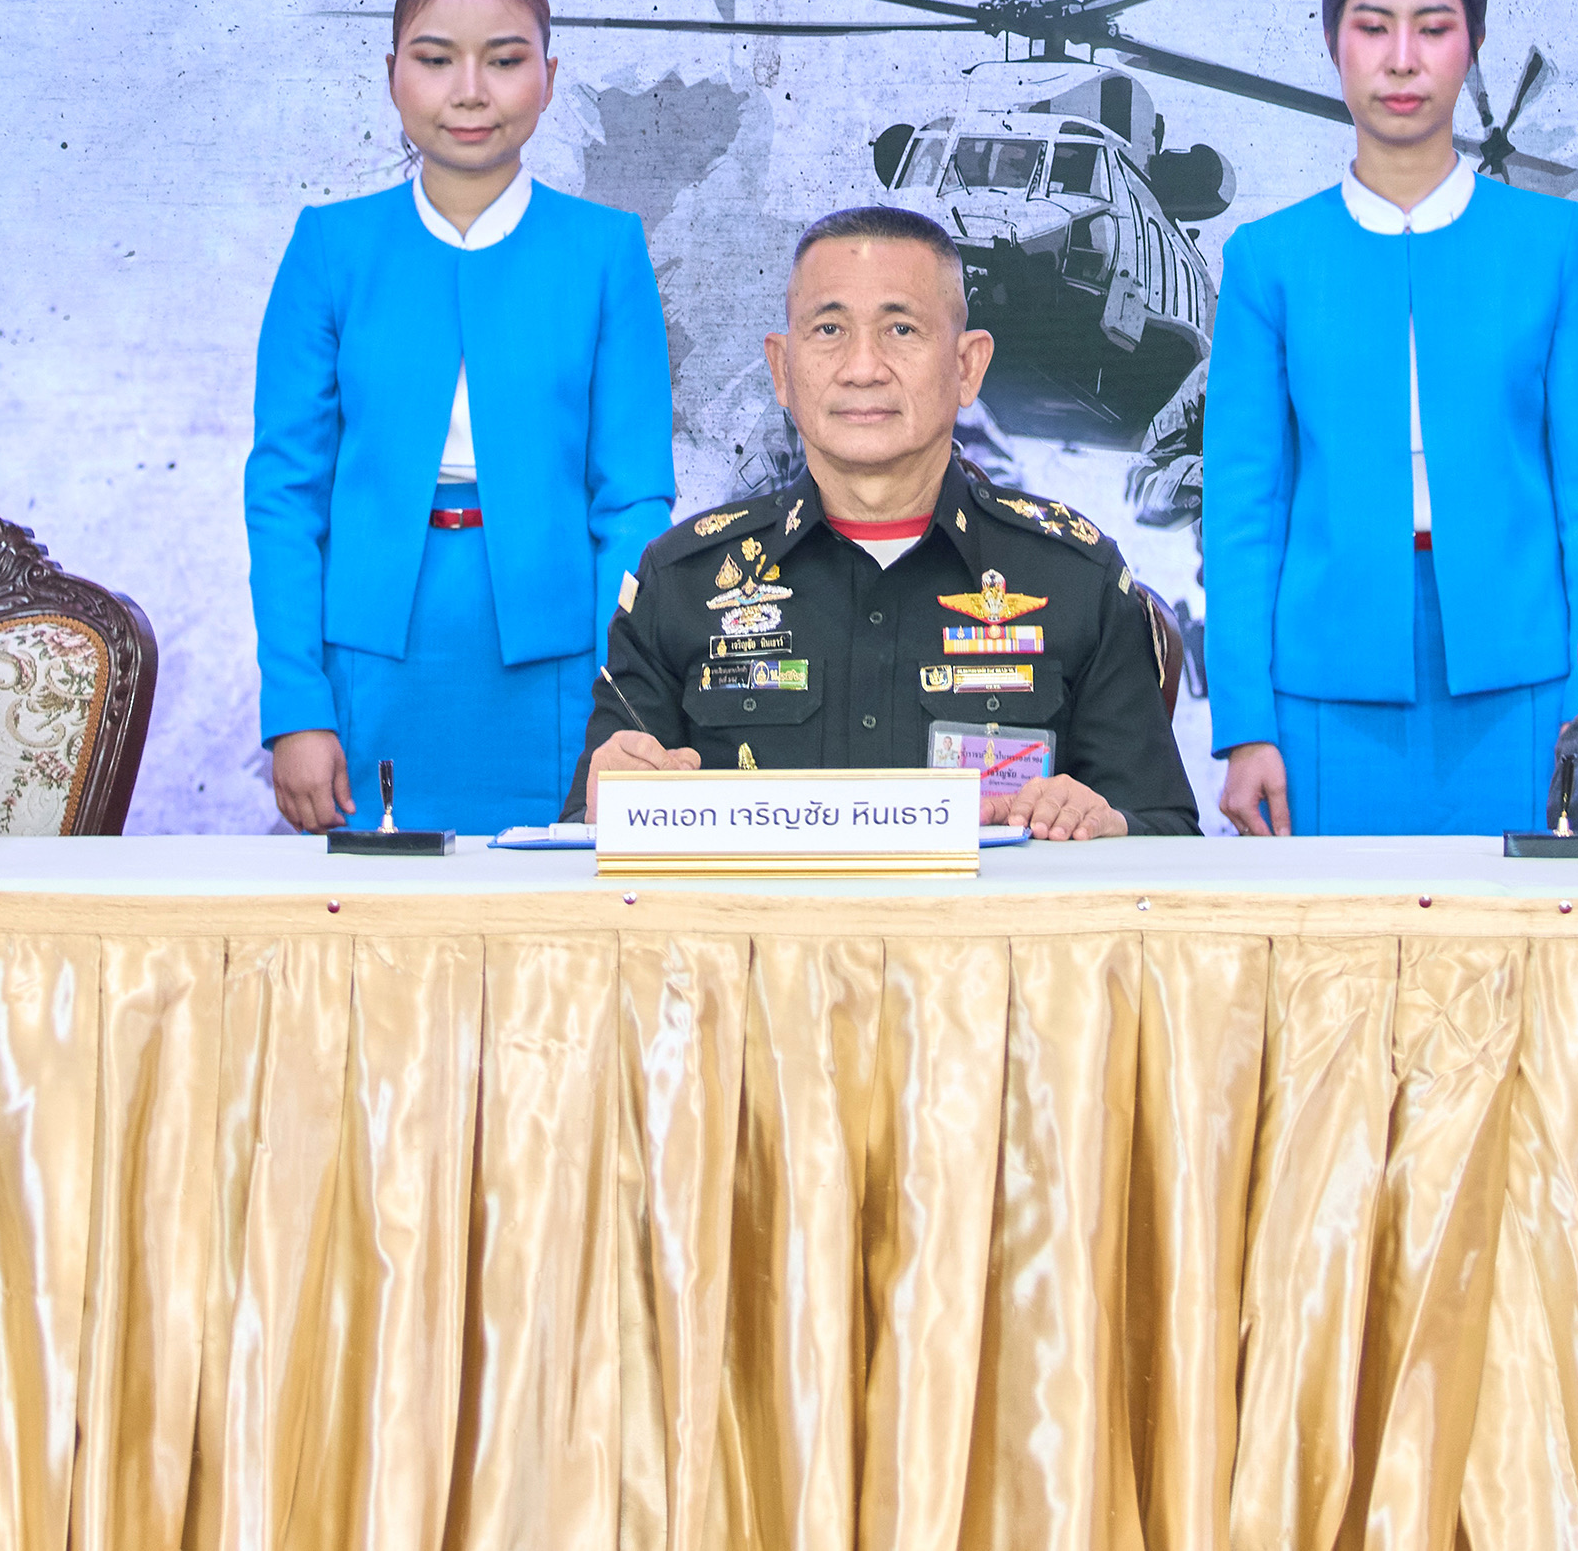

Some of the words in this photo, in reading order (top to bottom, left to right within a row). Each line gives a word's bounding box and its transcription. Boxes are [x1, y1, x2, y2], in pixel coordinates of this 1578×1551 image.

[628, 807, 717, 827] พลเอก
[730, 800, 839, 830] เจริญชัย
[852, 799, 950, 827] หินเธาว์
